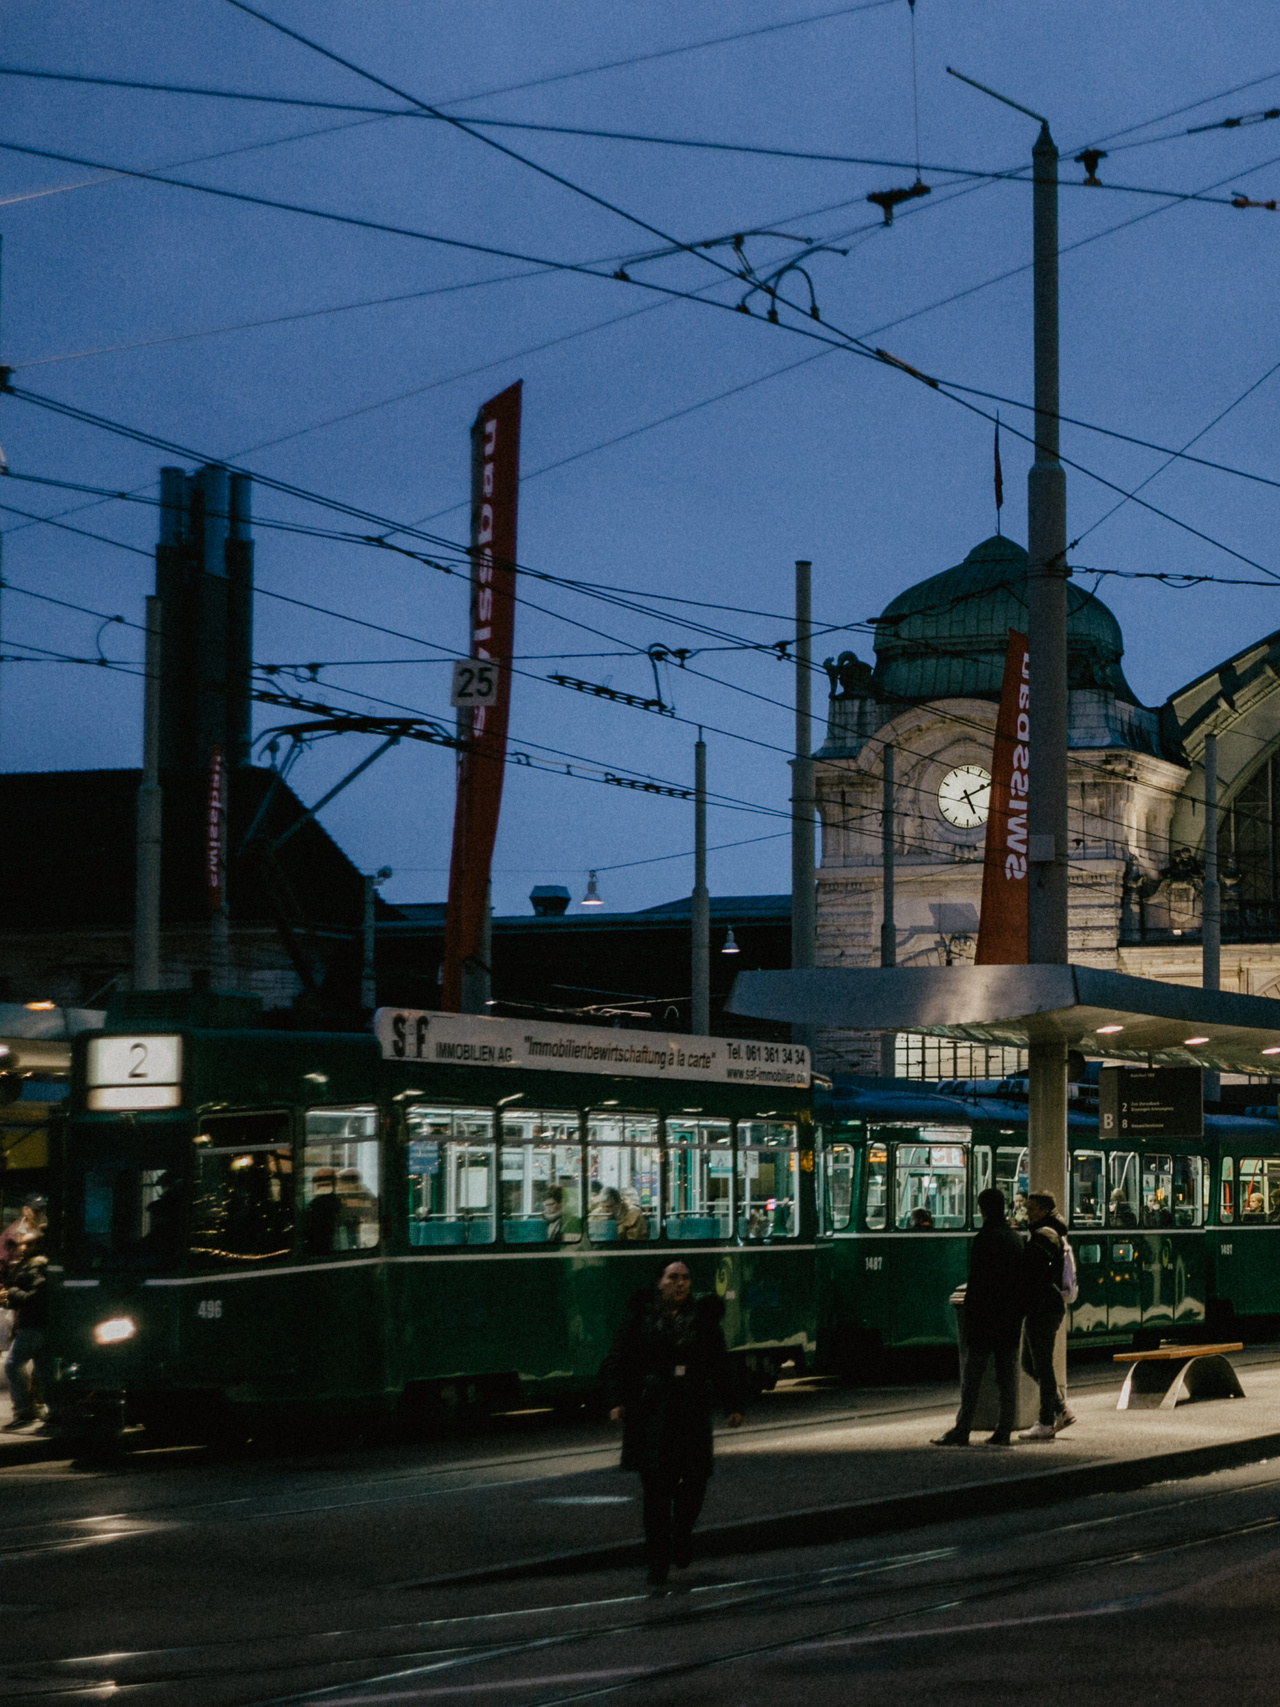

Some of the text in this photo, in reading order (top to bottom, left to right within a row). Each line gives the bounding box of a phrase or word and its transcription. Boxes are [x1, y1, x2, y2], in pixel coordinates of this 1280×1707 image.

[474, 418, 497, 737] sissbau
[457, 667, 494, 698] 25
[128, 1042, 148, 1078] 2
[436, 1042, 513, 1063] IMMOBILIEN AG
[525, 1036, 666, 1070] "Immobilienbewirtschaftung
[677, 1049, 685, 1067] la
[688, 1051, 716, 1069] carte"
[727, 1043, 805, 1065] Tel. 061 361 34 34
[1122, 1102, 1128, 1112] 2
[1104, 1113, 1114, 1129] B
[1122, 1119, 1128, 1129] 8
[865, 1256, 883, 1270] 1487
[198, 1300, 222, 1318] 496
